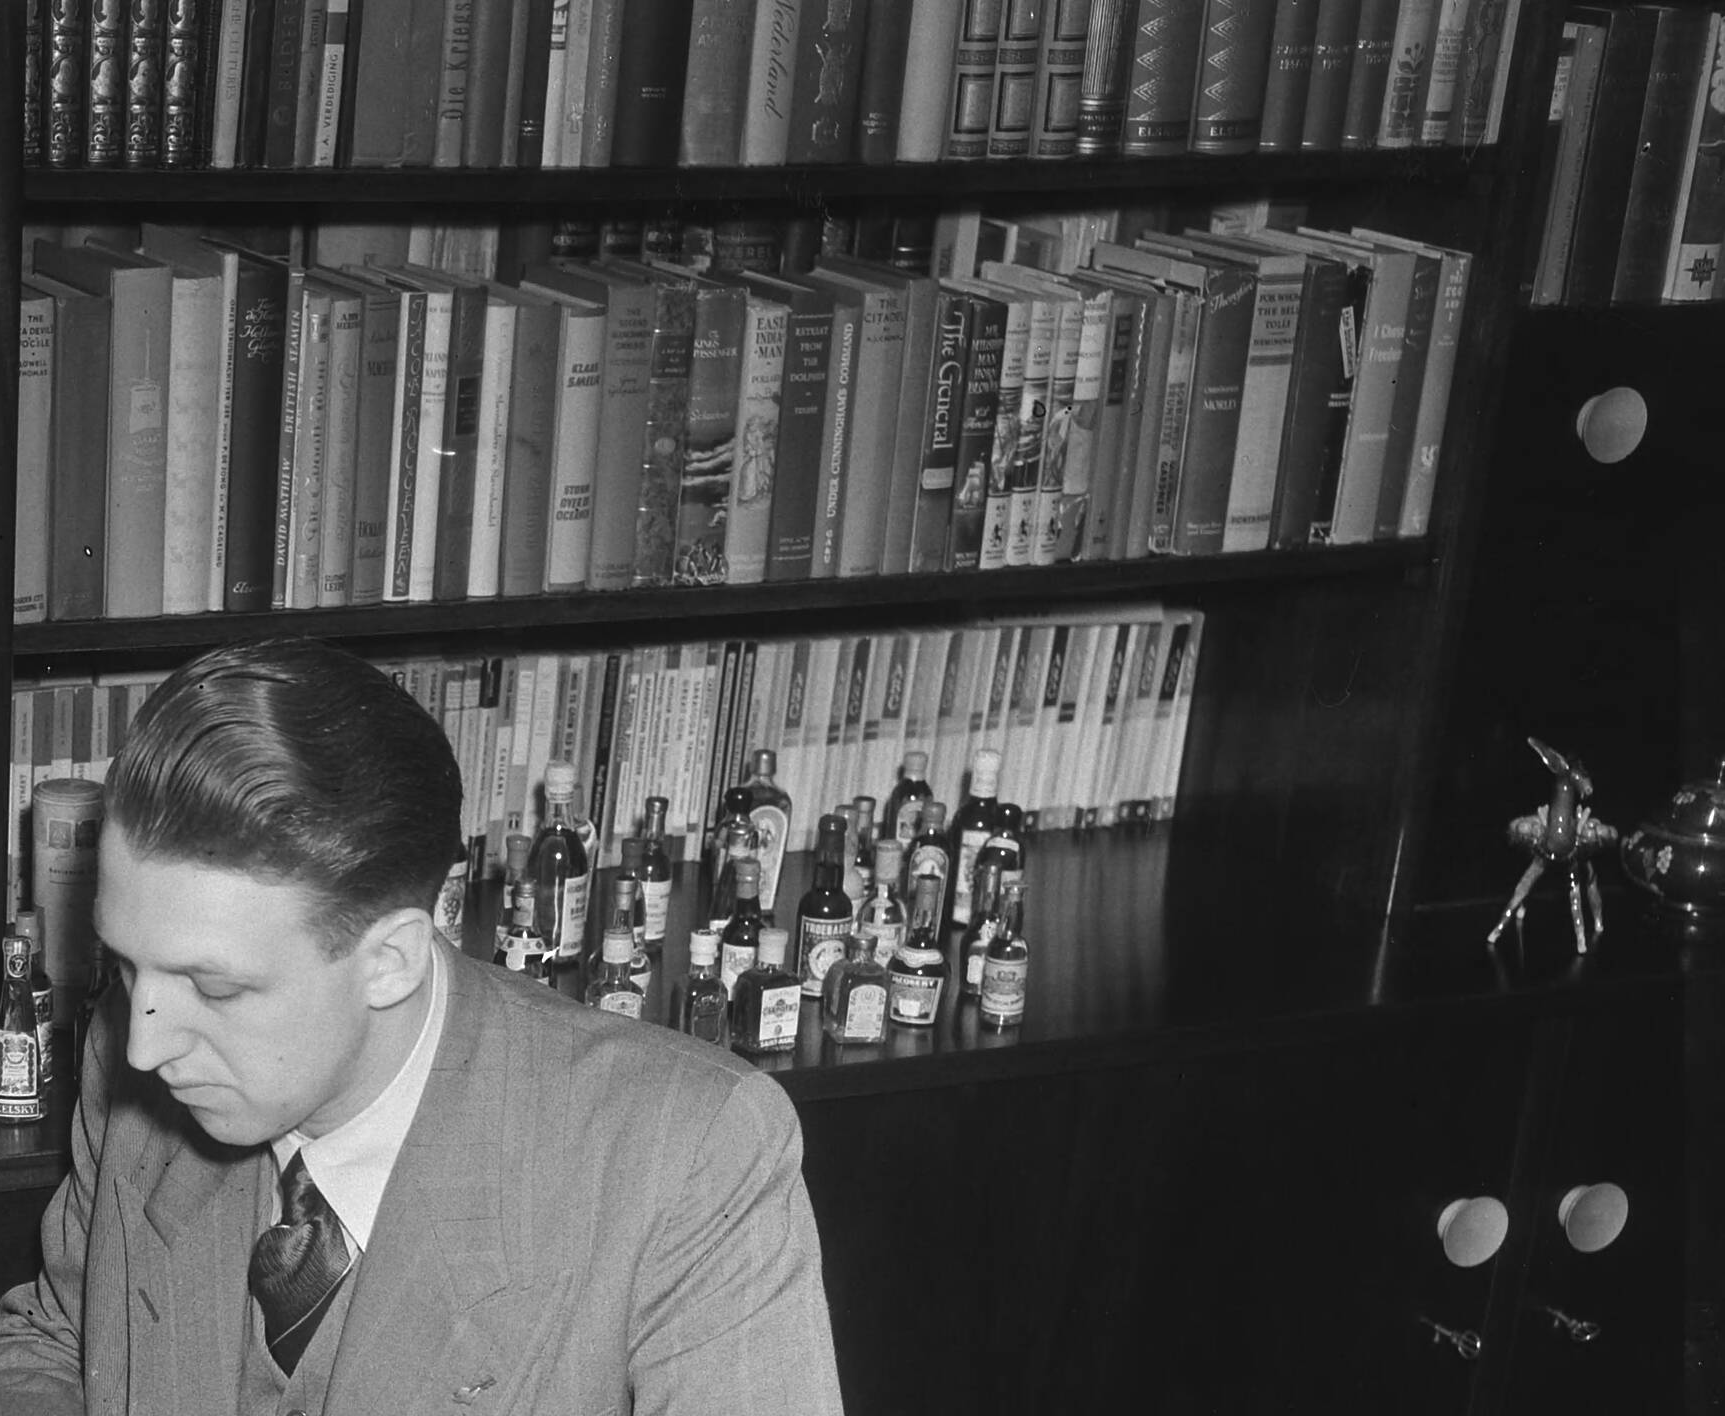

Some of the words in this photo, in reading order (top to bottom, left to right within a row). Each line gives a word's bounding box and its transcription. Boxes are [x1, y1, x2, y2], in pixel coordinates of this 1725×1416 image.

[323, 53, 338, 129] VERDEDIGING
[864, 312, 905, 323] CITADEL
[879, 299, 899, 309] THE
[1258, 307, 1277, 317] THE
[289, 309, 302, 365] SEAMEN
[839, 322, 854, 385] COMMAND
[941, 311, 966, 357] The
[284, 370, 297, 434] BRITISH
[933, 360, 963, 450] General
[831, 388, 848, 475] CUNNINGHAM'S
[279, 457, 292, 521] MATHEW
[826, 478, 840, 519] UNDER
[276, 526, 288, 567] DAVID
